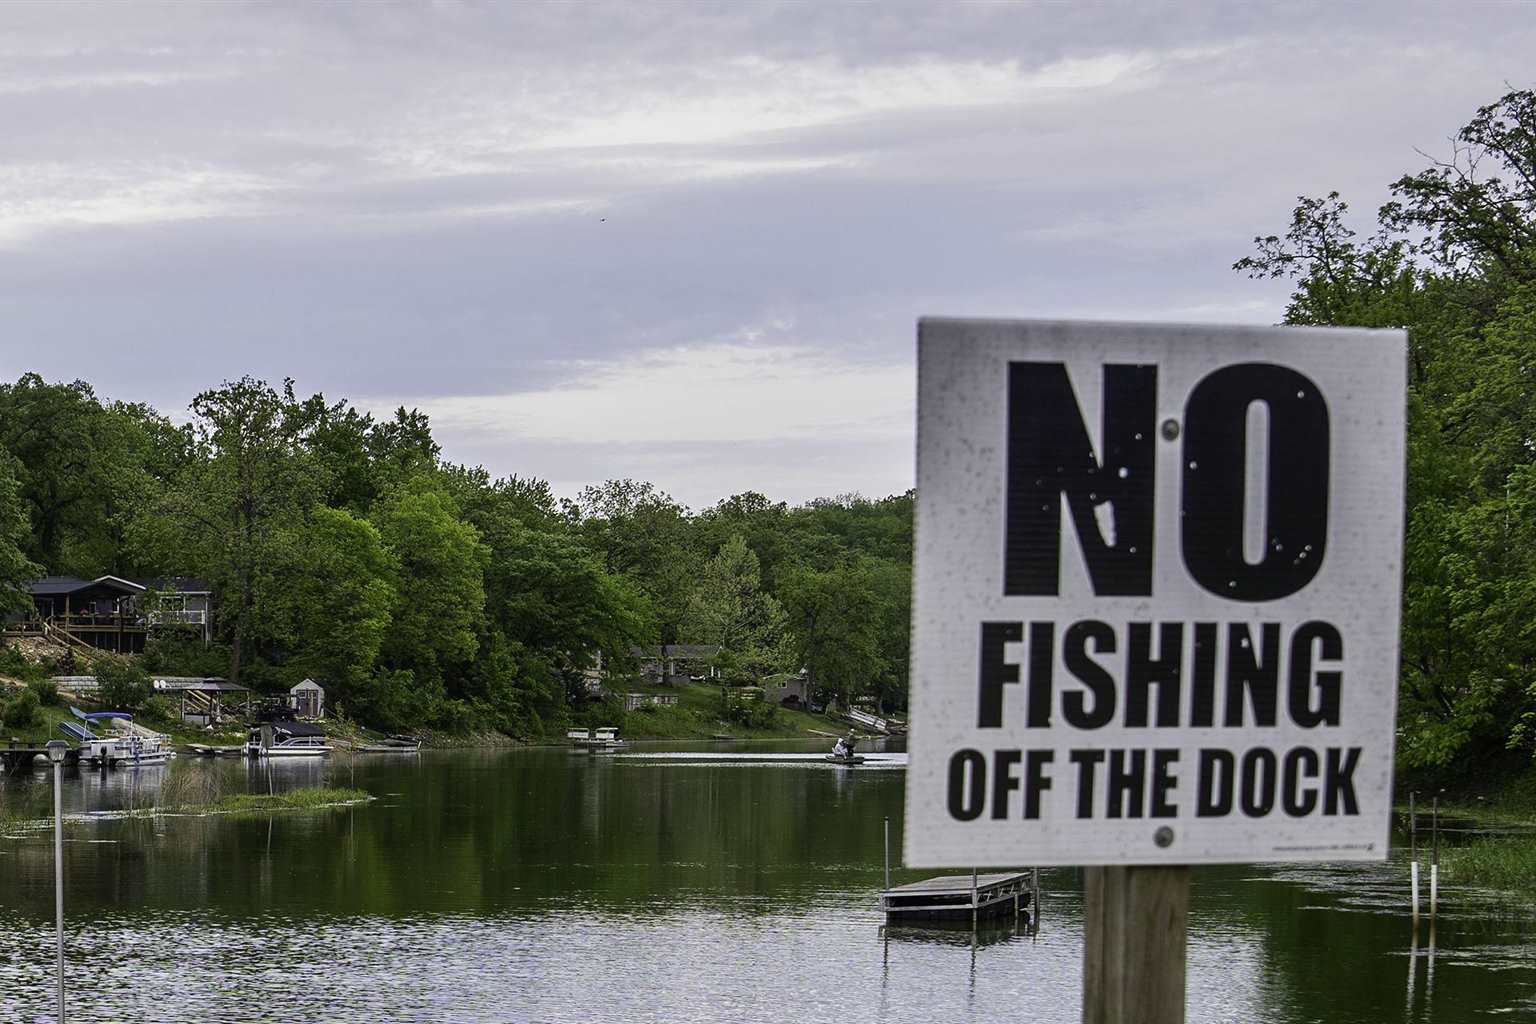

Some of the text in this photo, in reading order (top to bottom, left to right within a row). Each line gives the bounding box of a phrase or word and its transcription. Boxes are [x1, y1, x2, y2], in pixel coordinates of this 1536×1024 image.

[1003, 359, 1331, 603] NO
[977, 619, 1344, 730] FISHING
[947, 746, 1363, 821] OFF THE DOCK
